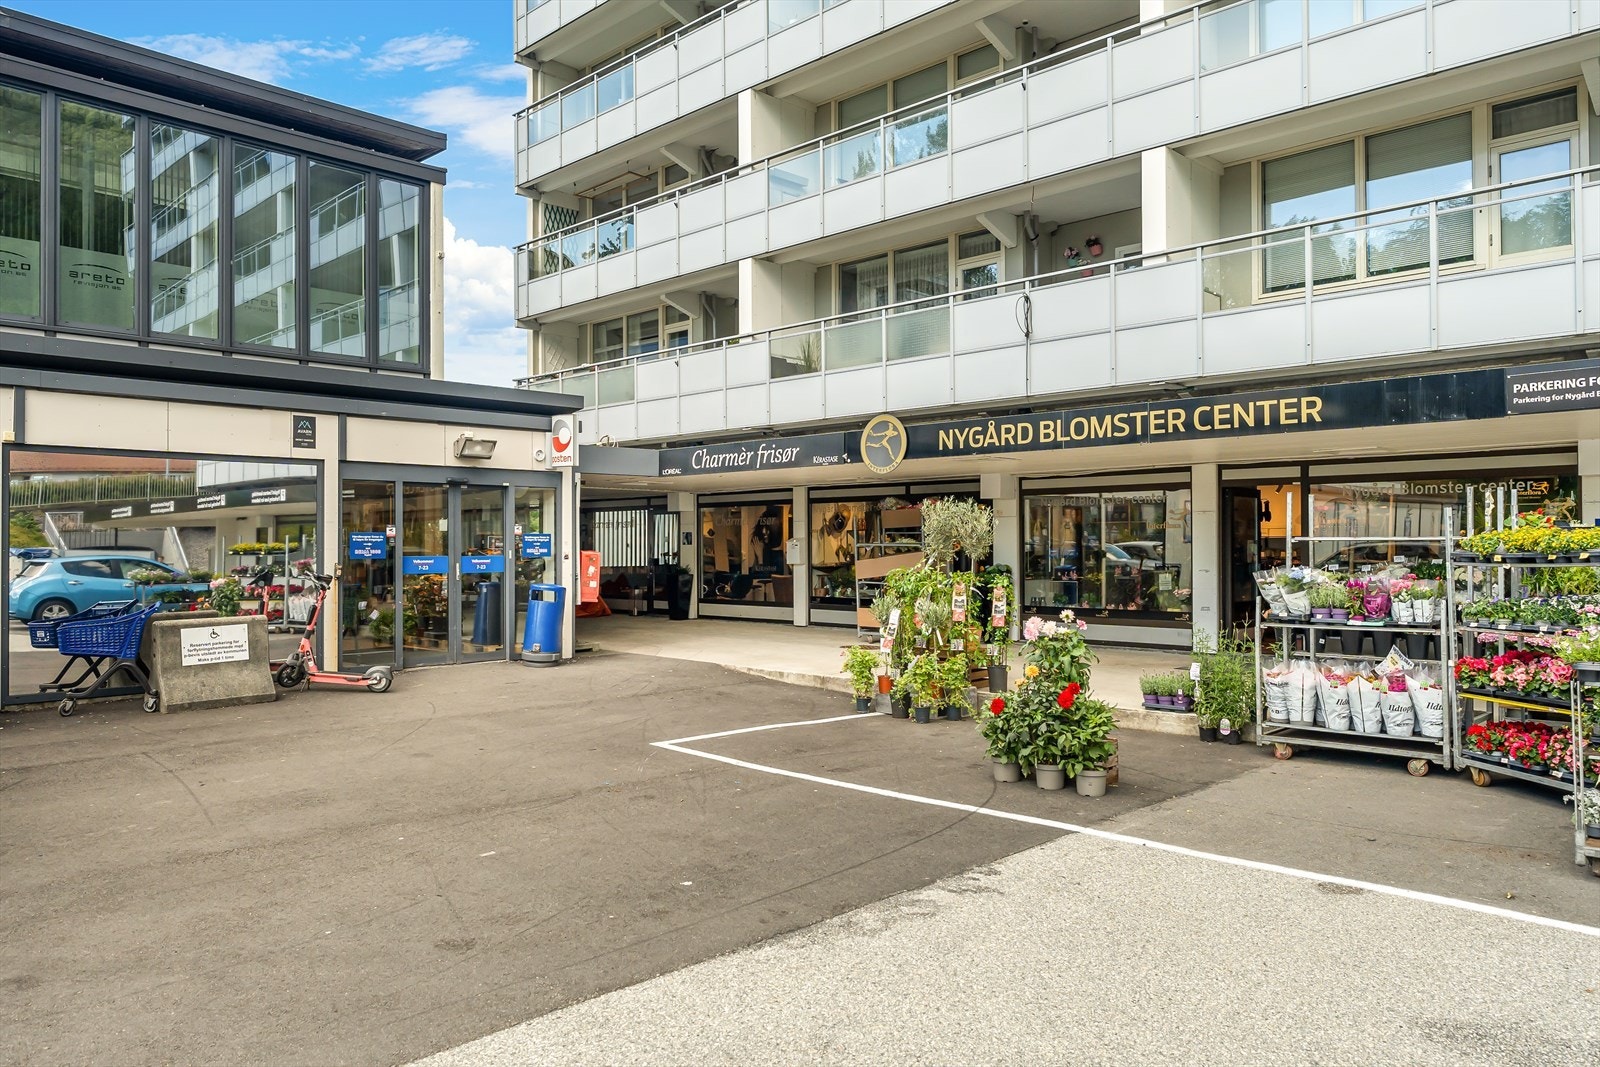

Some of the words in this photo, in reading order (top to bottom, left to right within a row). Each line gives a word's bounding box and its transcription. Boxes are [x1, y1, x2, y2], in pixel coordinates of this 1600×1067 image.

[68, 270, 125, 286] areto
[73, 279, 110, 289] revisjon
[1513, 377, 1587, 394] PARKERING
[1513, 395, 1551, 405] Parkering
[1551, 393, 1564, 401] for
[1565, 390, 1595, 401] Nygård
[938, 419, 1033, 450] NYGÅRD
[1040, 407, 1186, 443] BLOMSTER
[1193, 395, 1323, 432] CENTER
[691, 446, 754, 469] Charmèr
[756, 443, 800, 469] frisør
